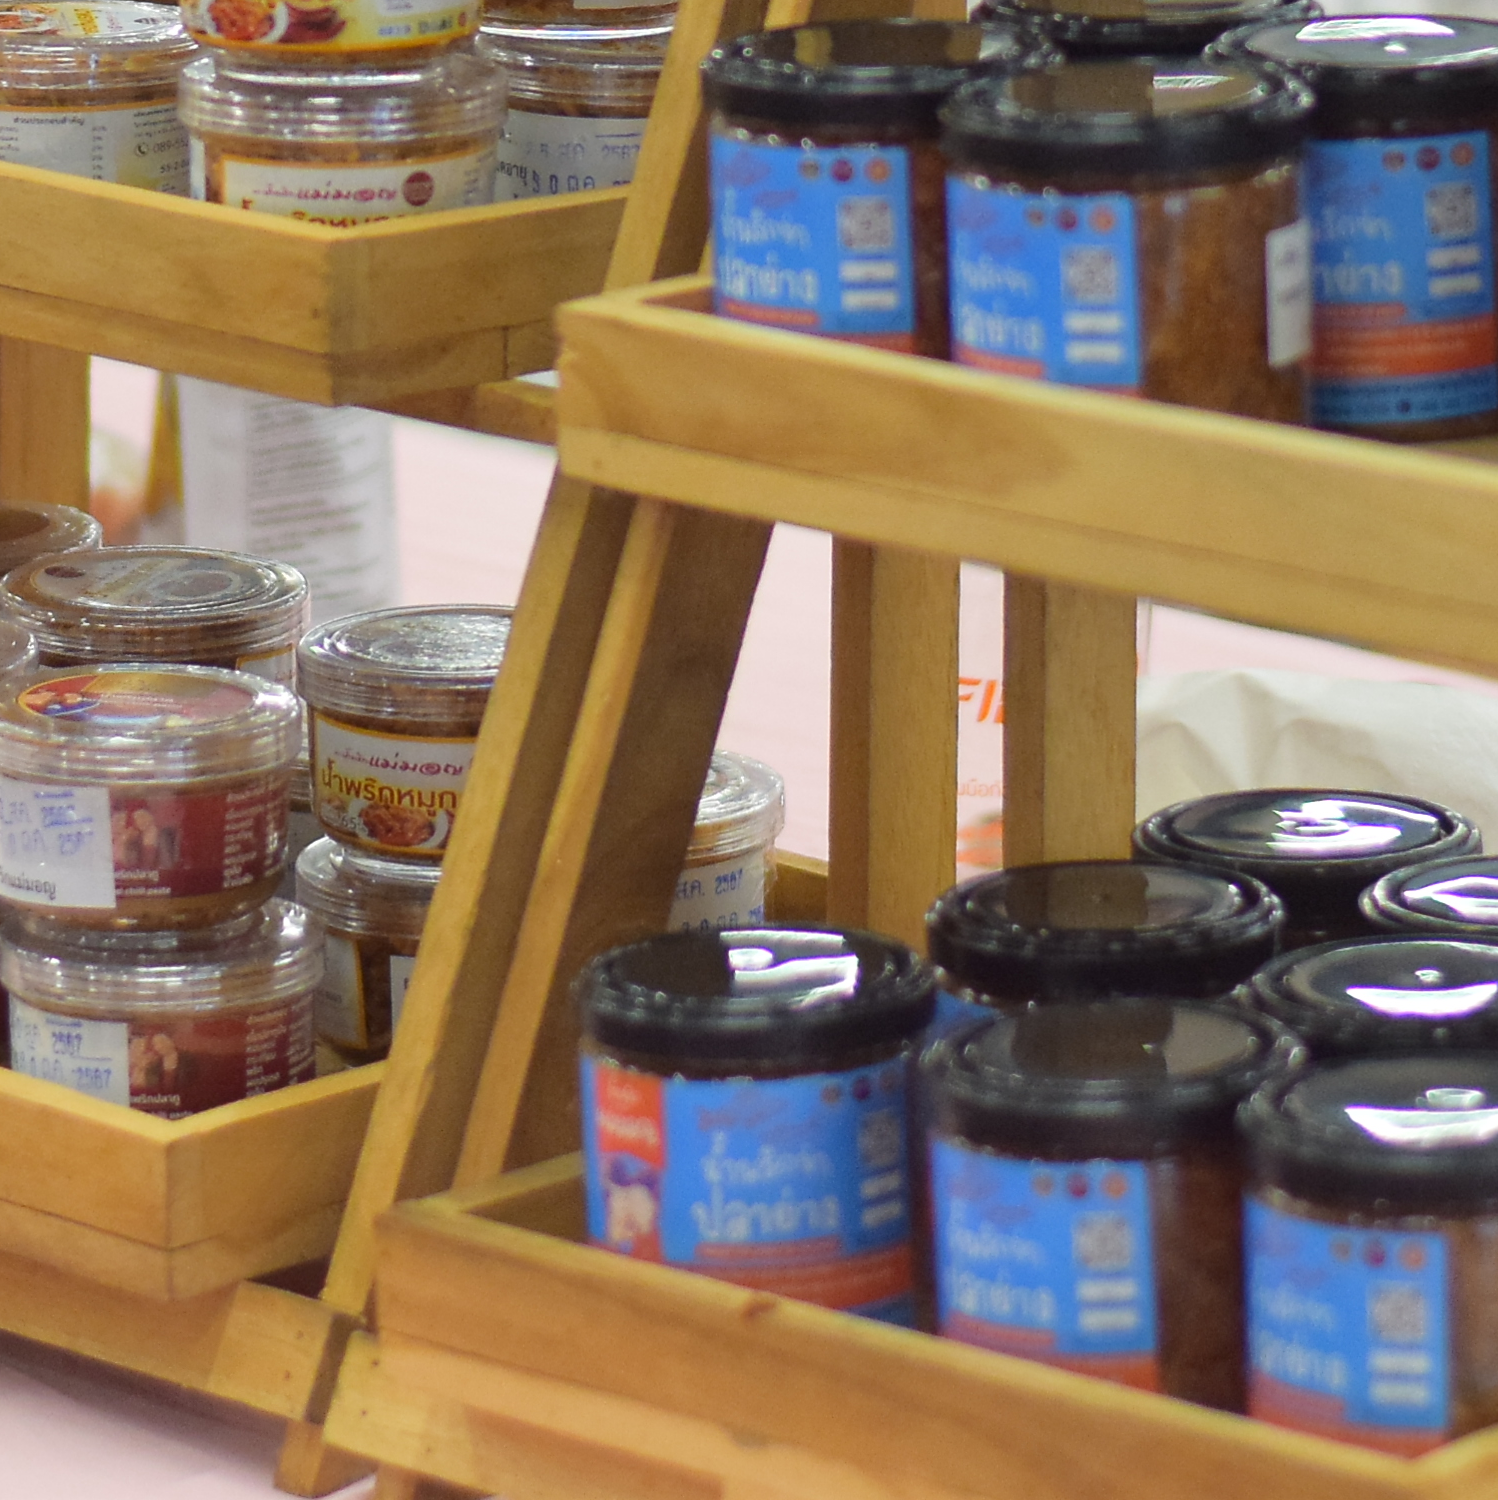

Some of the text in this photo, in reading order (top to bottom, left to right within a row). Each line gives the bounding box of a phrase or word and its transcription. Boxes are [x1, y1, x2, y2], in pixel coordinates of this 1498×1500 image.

[322, 758, 457, 816] น้ำพริกหมูก
